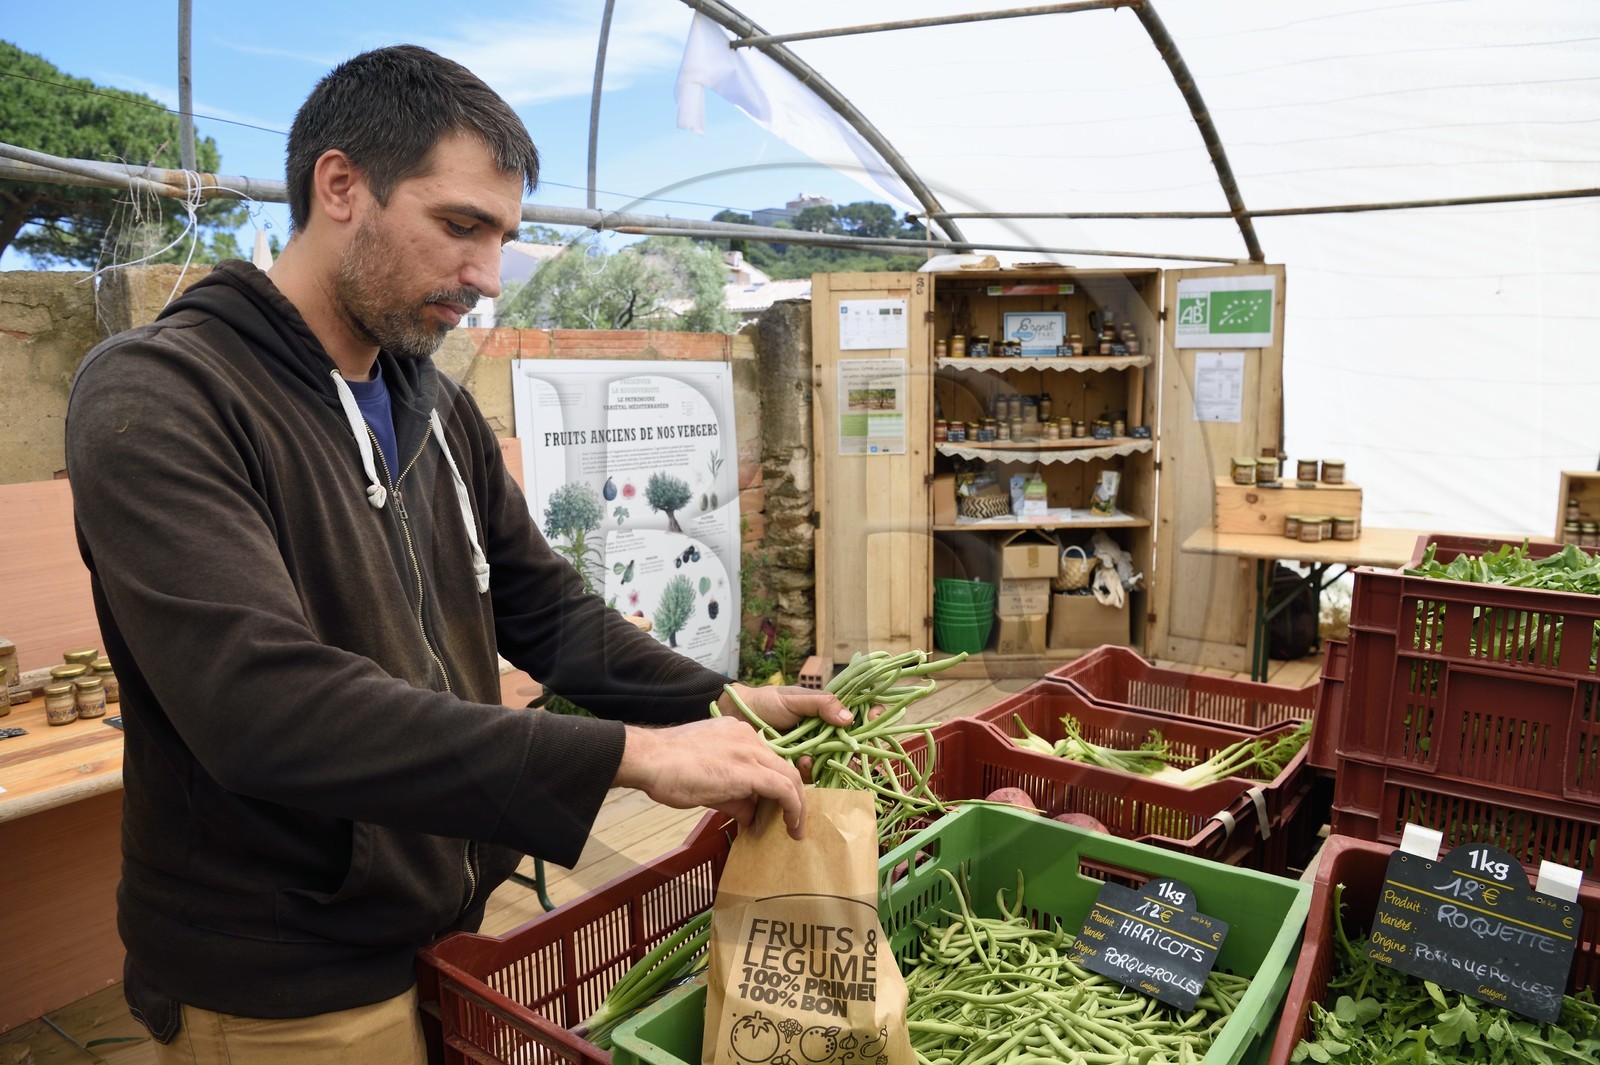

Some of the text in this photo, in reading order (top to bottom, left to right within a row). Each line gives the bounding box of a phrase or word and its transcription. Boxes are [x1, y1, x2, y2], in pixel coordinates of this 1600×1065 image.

[1180, 304, 1204, 324] AB
[544, 423, 718, 447] FRUITS ANCIENS DE NOS VERGERS
[1468, 849, 1510, 881] 1kg
[1158, 882, 1187, 905] 1kg
[1384, 889, 1421, 913] Produit
[1437, 904, 1556, 954] ROQUETTE
[1562, 916, 1575, 929] €
[748, 918, 878, 956] FRUITS &
[1212, 932, 1222, 942] €
[1372, 931, 1407, 953] Origine
[741, 967, 801, 992] 100%
[1104, 947, 1203, 996] PORQUEROLLES
[737, 984, 848, 1018] 100% BON
